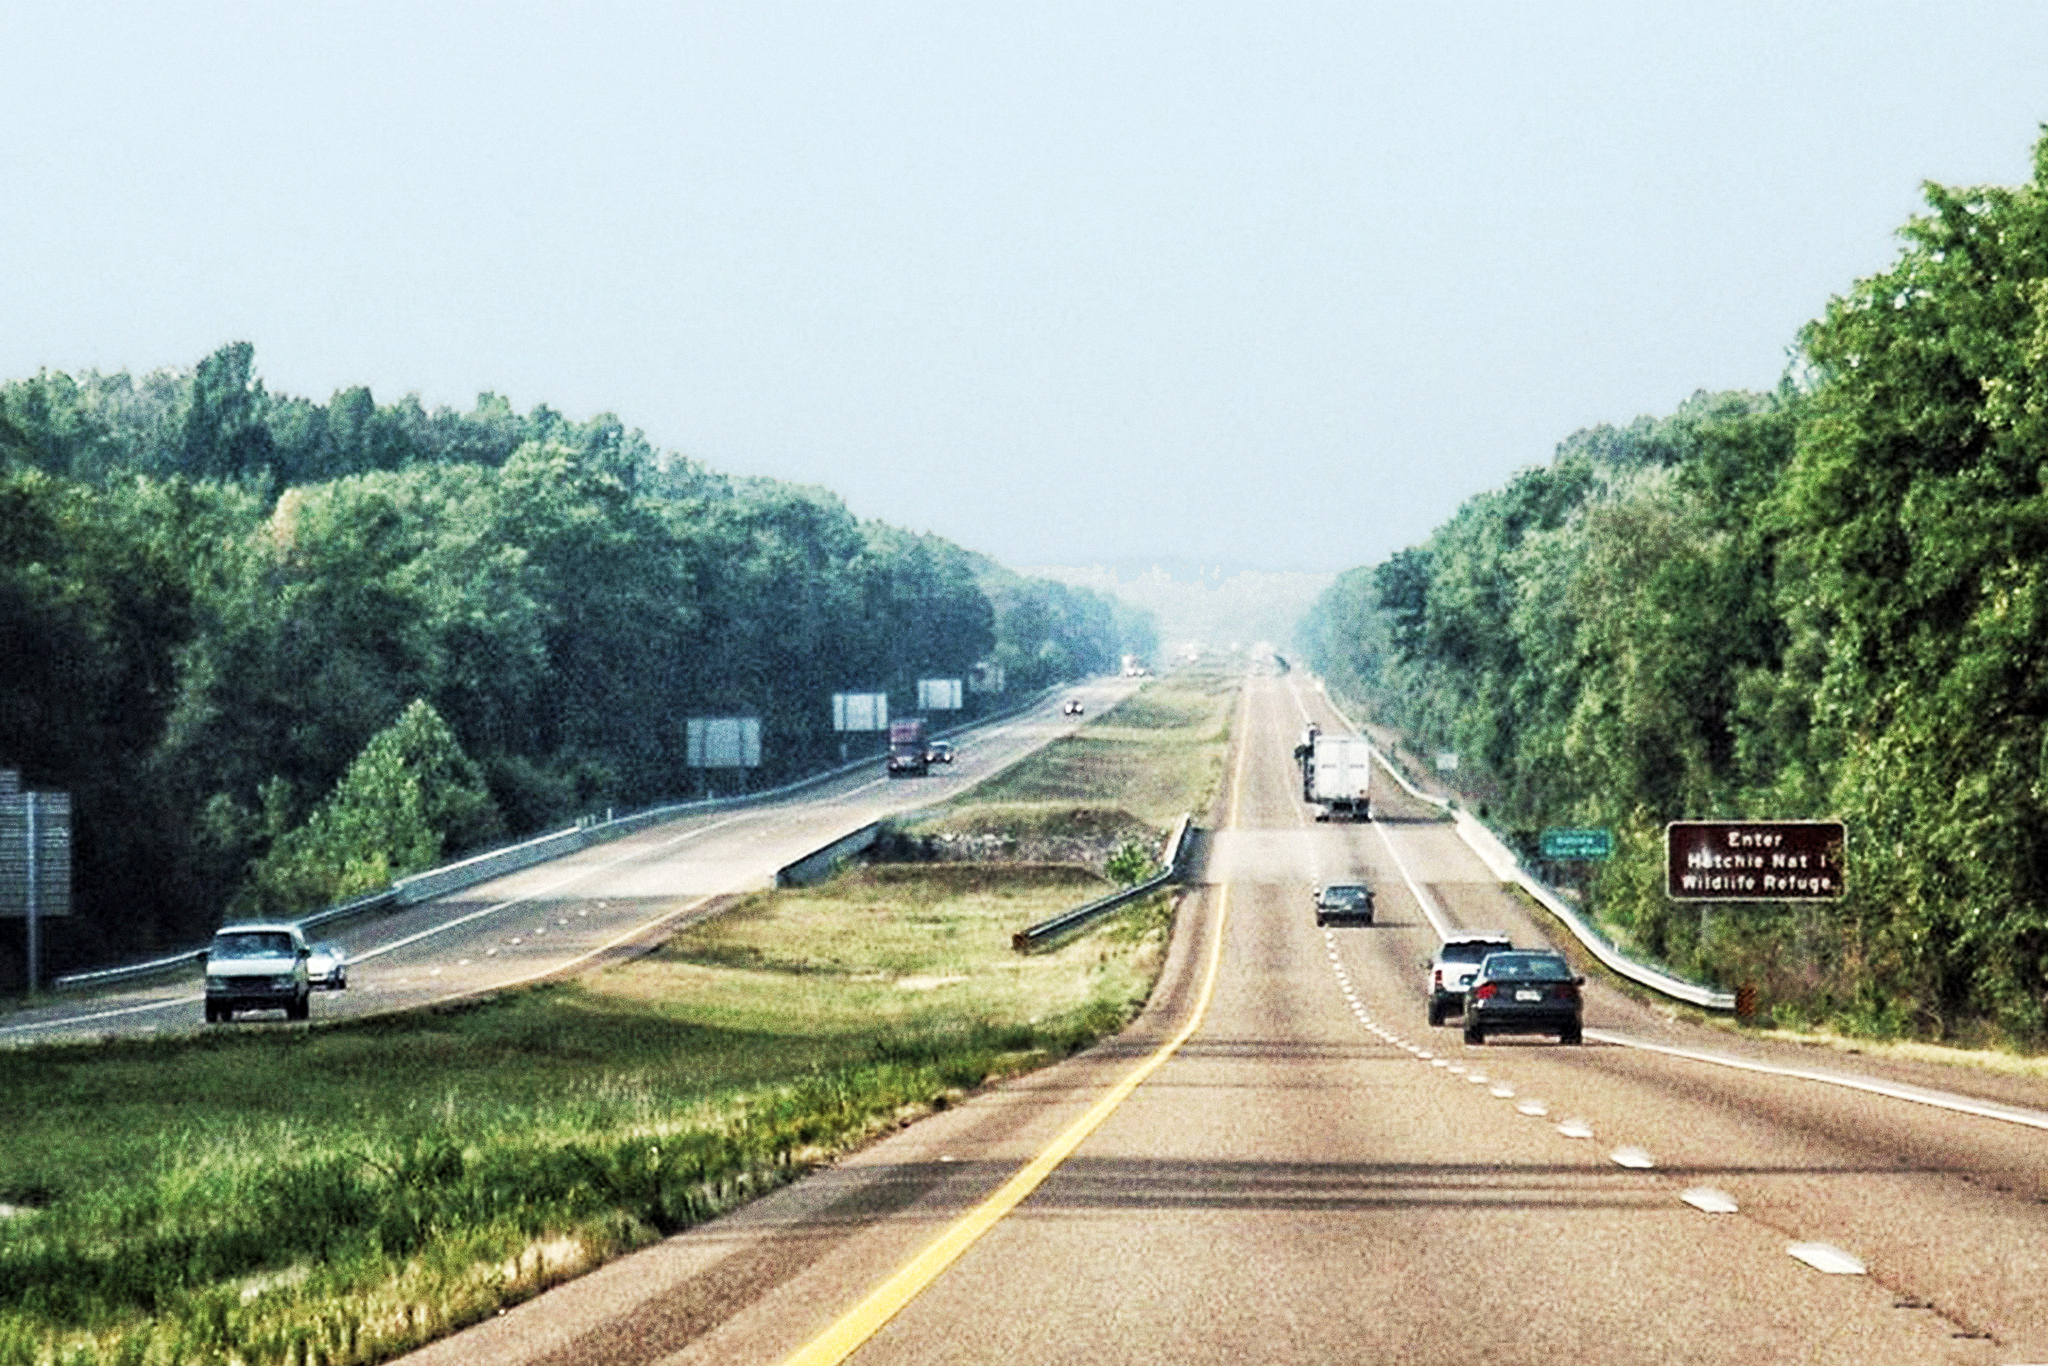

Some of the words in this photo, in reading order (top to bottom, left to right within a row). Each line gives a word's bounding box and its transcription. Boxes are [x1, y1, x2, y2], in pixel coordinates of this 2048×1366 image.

[1728, 831, 1783, 847] Enter
[1681, 874, 1755, 891] Wildlife
[1763, 874, 1831, 894] Refuge
